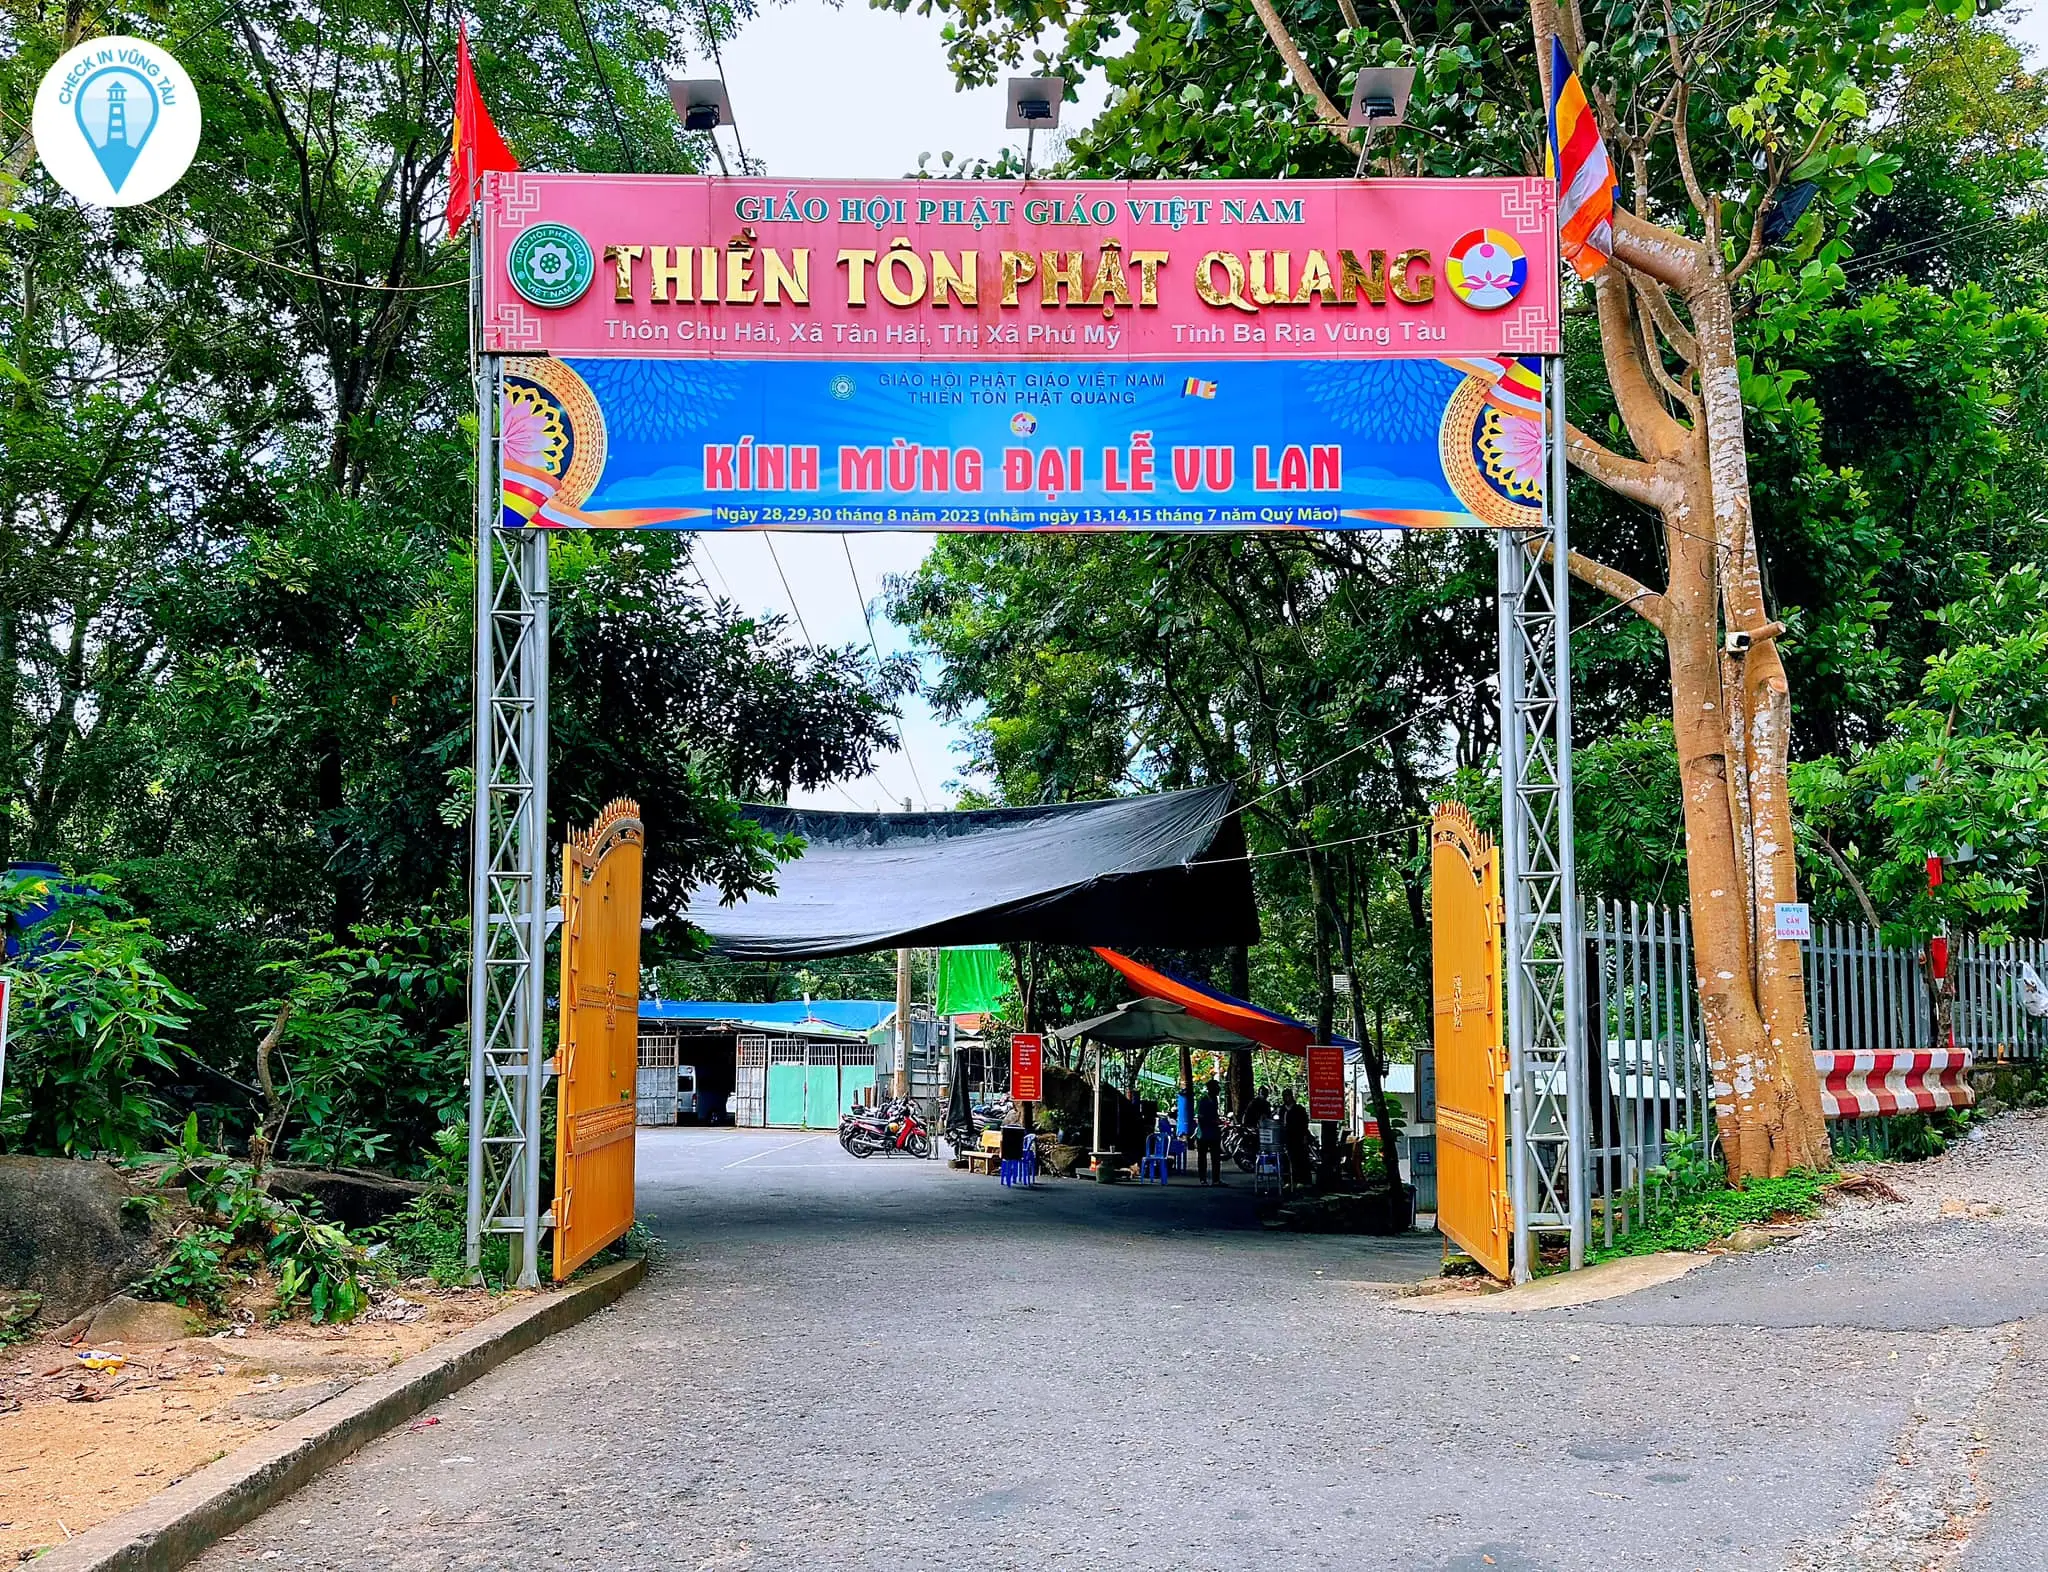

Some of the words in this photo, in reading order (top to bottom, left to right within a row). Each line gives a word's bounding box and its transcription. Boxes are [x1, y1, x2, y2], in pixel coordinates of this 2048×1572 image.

[735, 190, 829, 222] GIÁO
[838, 195, 906, 230] HỘI
[916, 197, 1013, 231] PHẬT
[1024, 193, 1117, 226] GIÁO
[1125, 195, 1212, 230] VIỆT
[1220, 198, 1305, 224] NAM
[603, 227, 811, 308] THIỀN
[836, 236, 979, 308] TÔN
[999, 237, 1169, 319] PHẬT
[1195, 249, 1436, 314] QUANG
[550, 285, 573, 298] NAM
[604, 319, 669, 342] Thôn
[677, 322, 727, 342] Chu
[735, 321, 782, 345] Hải,
[790, 322, 823, 343] Xã
[831, 323, 882, 344] Tân
[886, 323, 932, 346] Hải,
[939, 324, 979, 348] Thị
[987, 323, 1020, 344] Xã
[1027, 323, 1076, 344] Phú
[1084, 323, 1121, 348] Mỹ
[1171, 324, 1225, 342] Tỉnh
[1275, 323, 1316, 347] Rịa
[1324, 322, 1390, 345] Vũng
[1399, 320, 1447, 340] Tàu
[880, 371, 924, 387] GIÁO
[931, 371, 961, 389] HỘI
[969, 371, 1017, 389] PHẬT
[1025, 371, 1070, 387] GIÁO
[1077, 371, 1117, 389] VIỆT
[1126, 374, 1164, 387] NAM
[970, 389, 1007, 404] TÔN
[1015, 389, 1063, 407] PHẬT
[1071, 391, 1135, 405] QUANG
[703, 435, 820, 491] KÍNH
[838, 437, 983, 492] MỪNG
[1003, 447, 1083, 501] ĐẠI
[1103, 430, 1154, 492] LỄ
[1172, 446, 1235, 492] VU
[1253, 445, 1342, 492] LAN
[716, 507, 758, 523] Ngày
[762, 507, 832, 522] 28,29,30
[836, 508, 883, 524] tháng
[887, 509, 897, 521] 8
[901, 508, 936, 522] năm
[940, 509, 980, 522] 2023
[984, 507, 1035, 524] (nhằm
[1039, 509, 1079, 525] ngày
[1083, 509, 1152, 523] 13,14,15
[1155, 508, 1203, 524] tháng
[1207, 509, 1217, 521] 7
[1221, 508, 1256, 521] năm
[1260, 507, 1293, 524] Quý
[1298, 507, 1338, 522] Mão)
